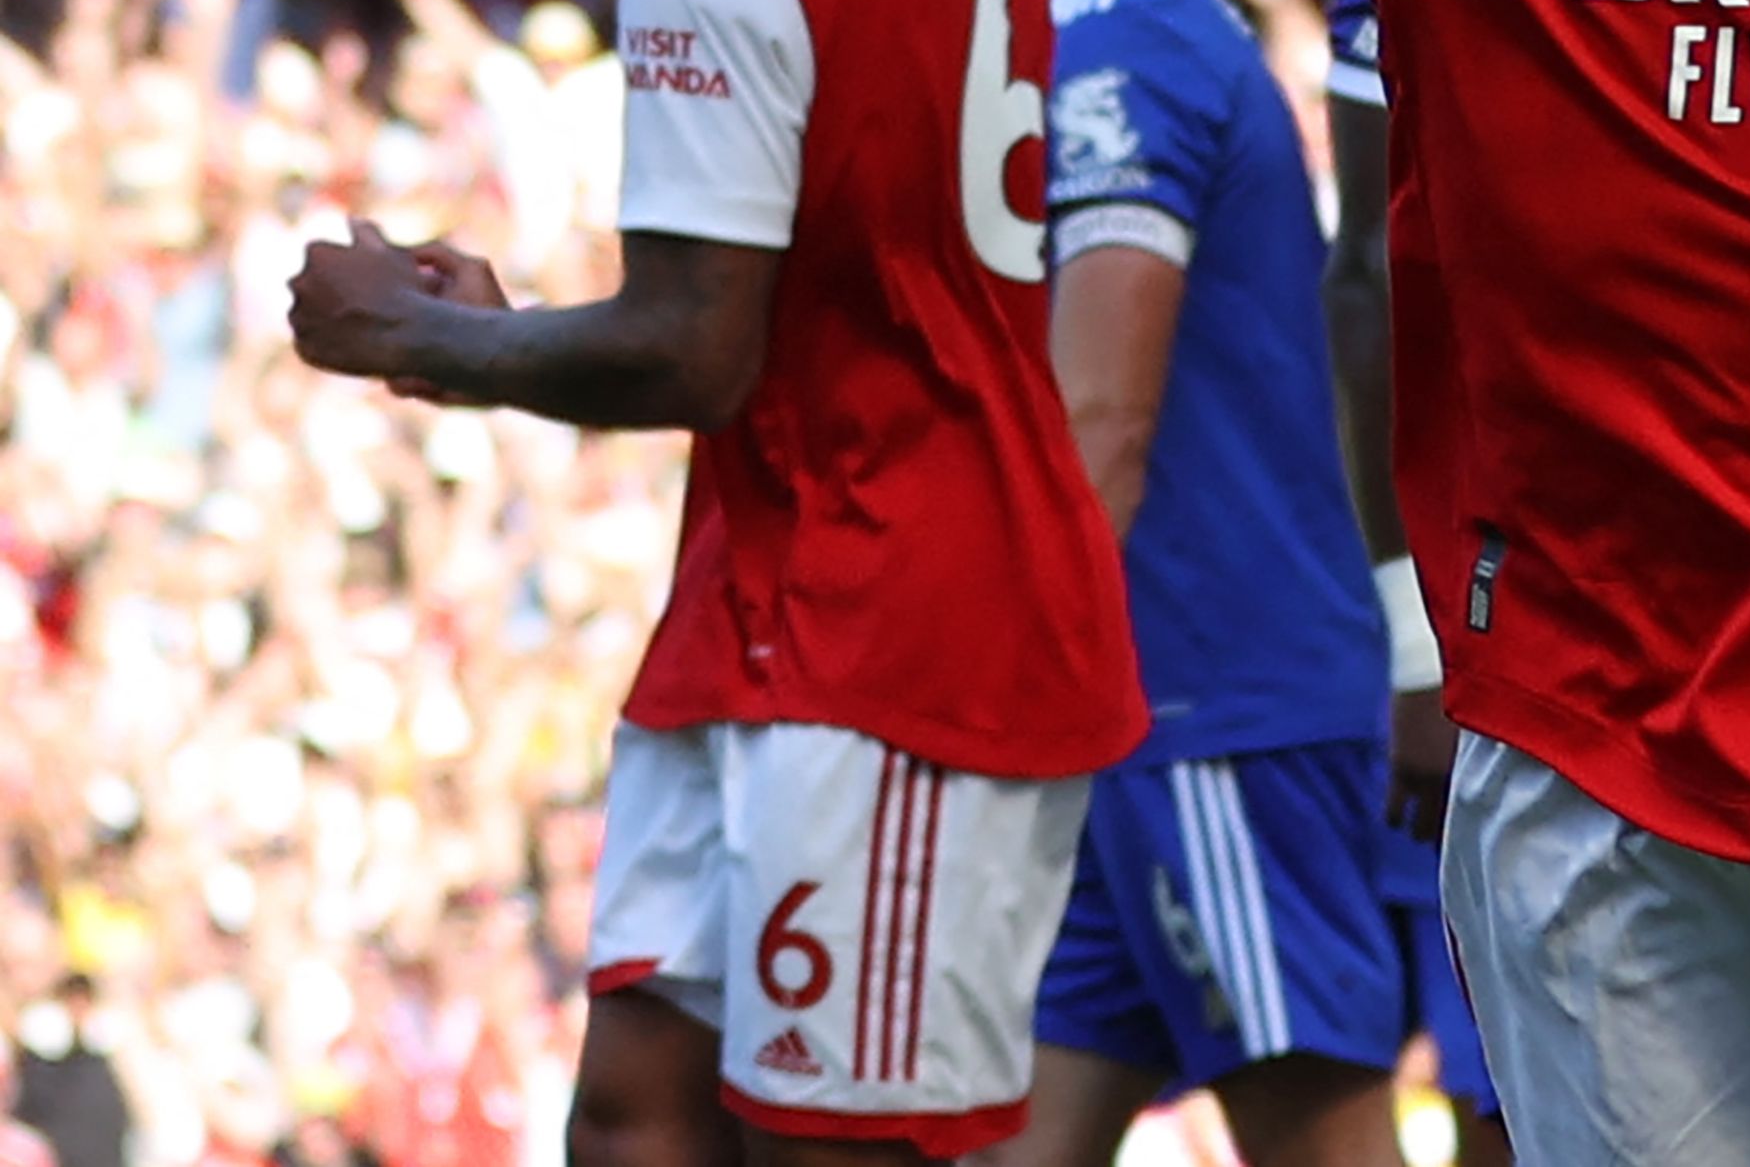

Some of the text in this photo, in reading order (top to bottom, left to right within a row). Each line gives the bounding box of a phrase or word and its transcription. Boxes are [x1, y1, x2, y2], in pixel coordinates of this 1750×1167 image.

[626, 28, 696, 58] VISIT
[627, 64, 732, 99] ANDA
[756, 880, 833, 1010] 6
